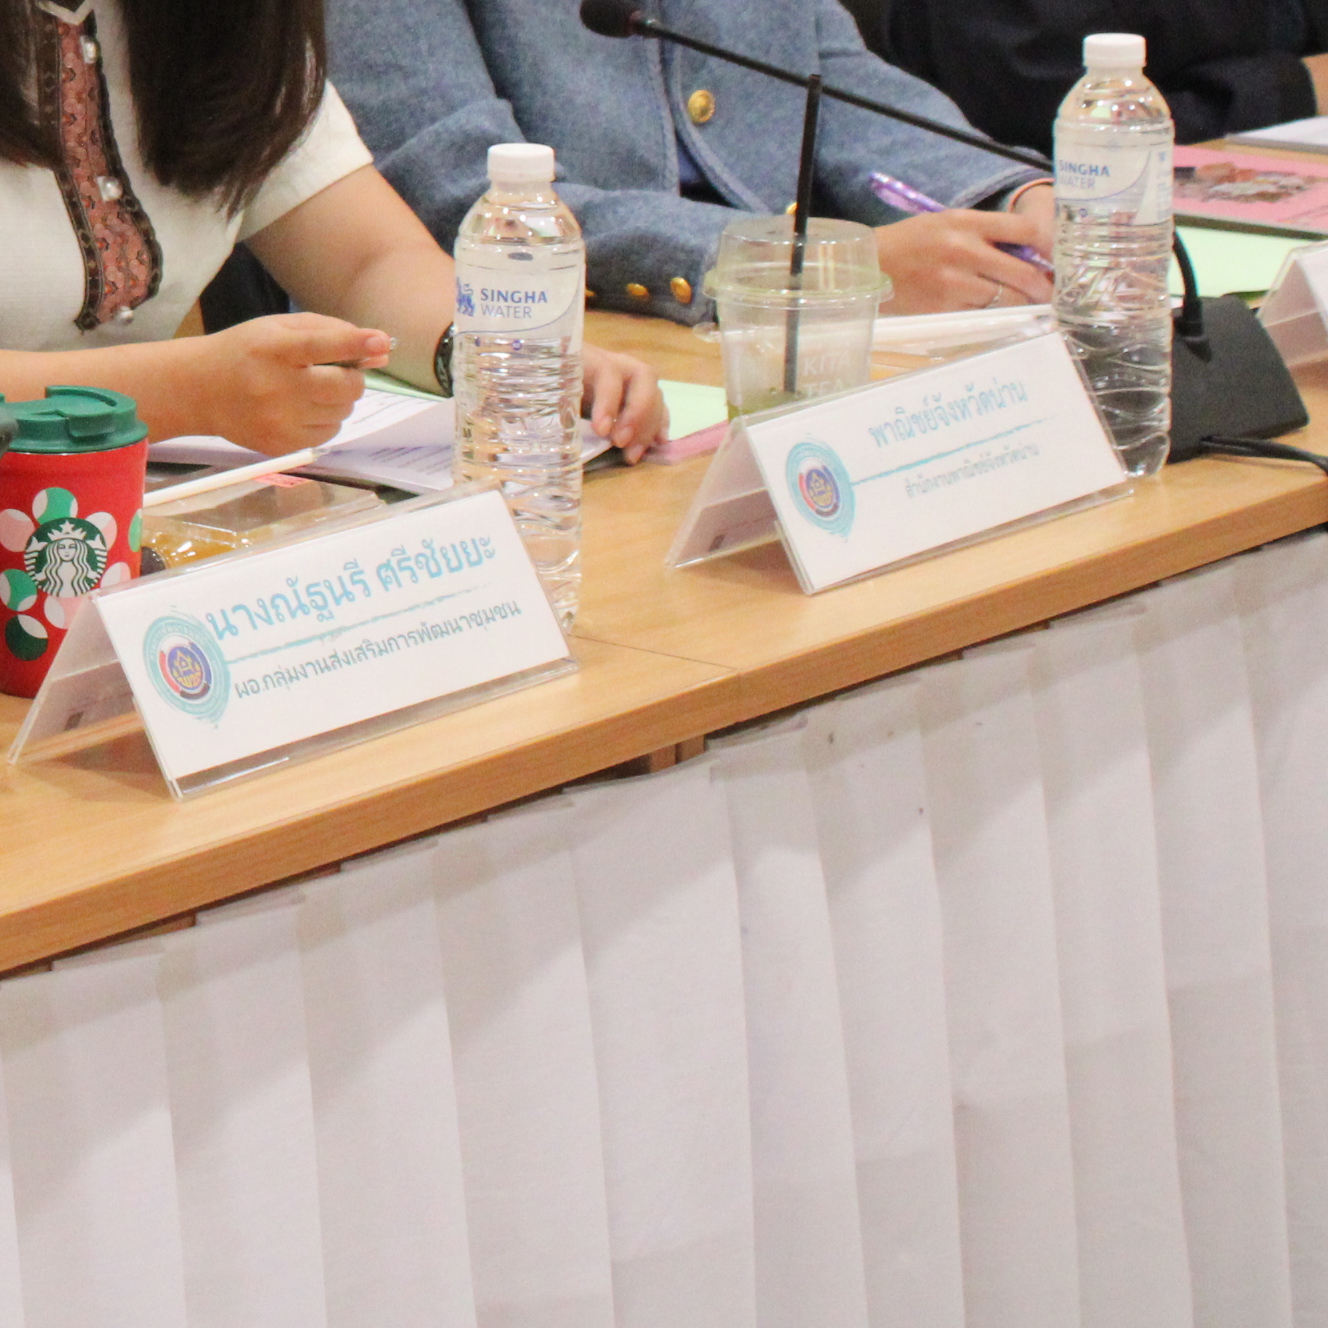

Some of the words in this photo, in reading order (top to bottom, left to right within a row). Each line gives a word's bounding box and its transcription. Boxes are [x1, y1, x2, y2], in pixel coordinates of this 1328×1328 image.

[1059, 159, 1111, 177] SINGHA
[480, 288, 548, 304] SINGHA
[480, 304, 532, 319] WATER
[205, 558, 372, 640] นางณัฐนรี
[376, 536, 497, 593] ศรีชัยยะ
